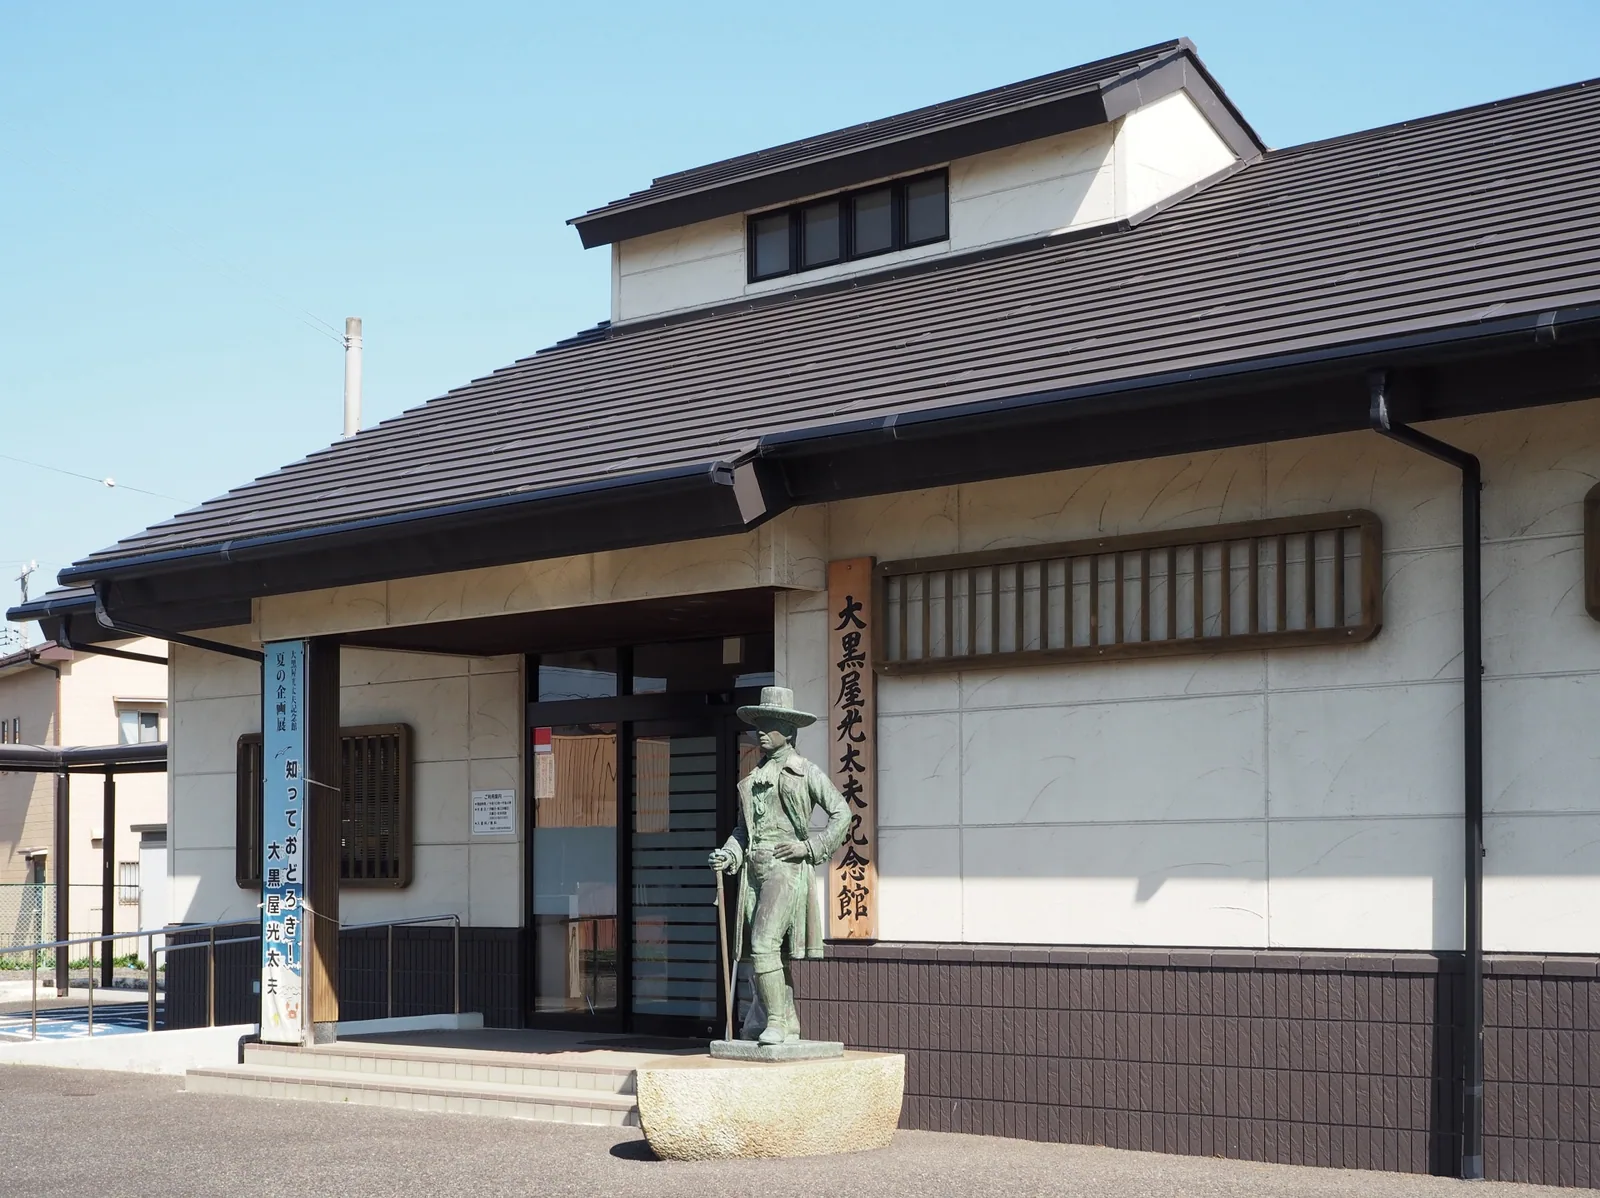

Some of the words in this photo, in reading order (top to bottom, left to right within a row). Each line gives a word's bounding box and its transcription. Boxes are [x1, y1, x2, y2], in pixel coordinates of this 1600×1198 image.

[276, 652, 287, 732] 夏の企画展
[834, 595, 870, 921] 大黒屋光太夫記念館
[266, 841, 281, 995] 大黒屋光太夫
